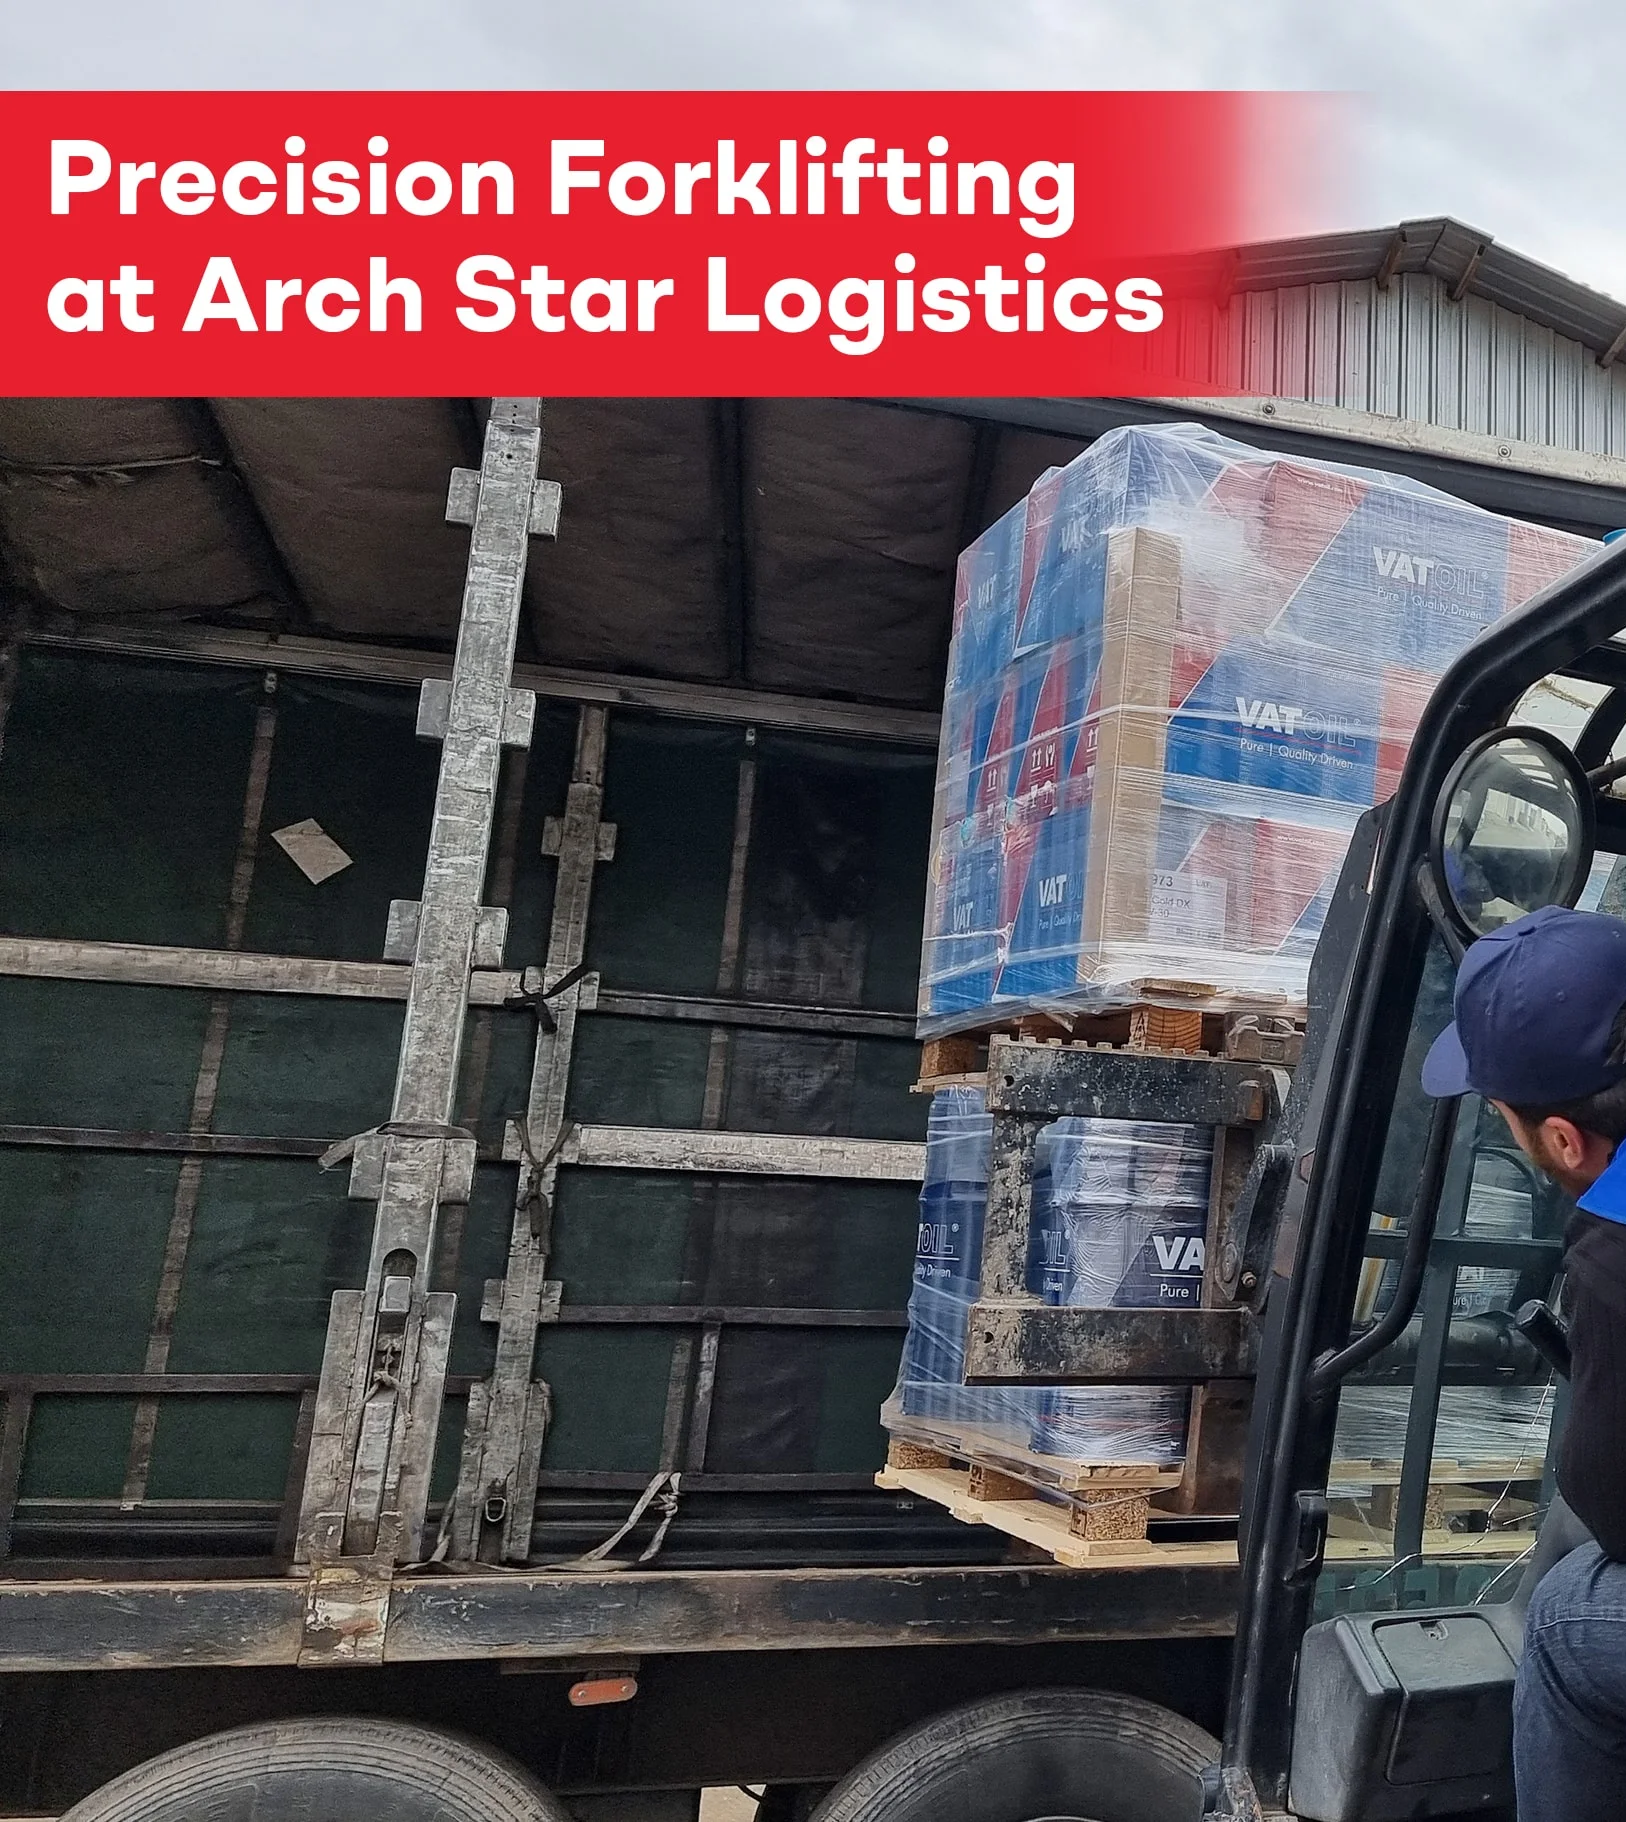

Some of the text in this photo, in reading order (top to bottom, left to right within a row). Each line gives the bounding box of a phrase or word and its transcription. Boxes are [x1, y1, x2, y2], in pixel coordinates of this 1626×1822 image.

[1240, 738, 1353, 770] Pure Quality Driven
[1159, 1283, 1190, 1298] Pure
